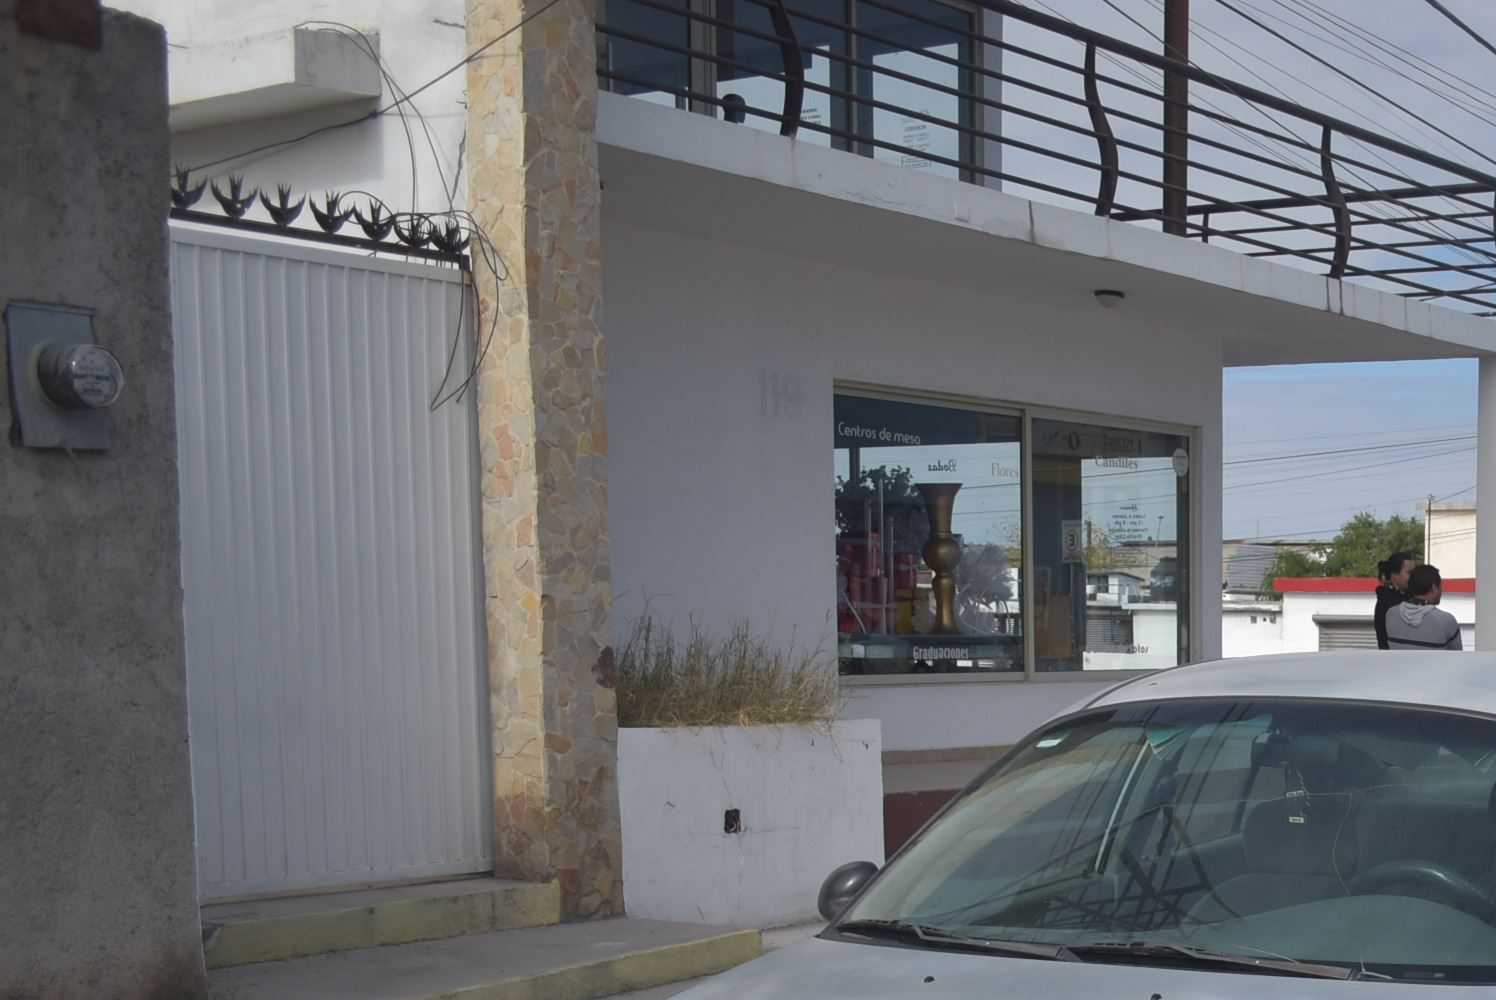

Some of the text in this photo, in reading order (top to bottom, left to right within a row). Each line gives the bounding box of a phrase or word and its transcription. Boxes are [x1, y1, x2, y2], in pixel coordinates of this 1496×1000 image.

[838, 422, 921, 445] Centros de mesa
[912, 646, 970, 660] Graduaciones
